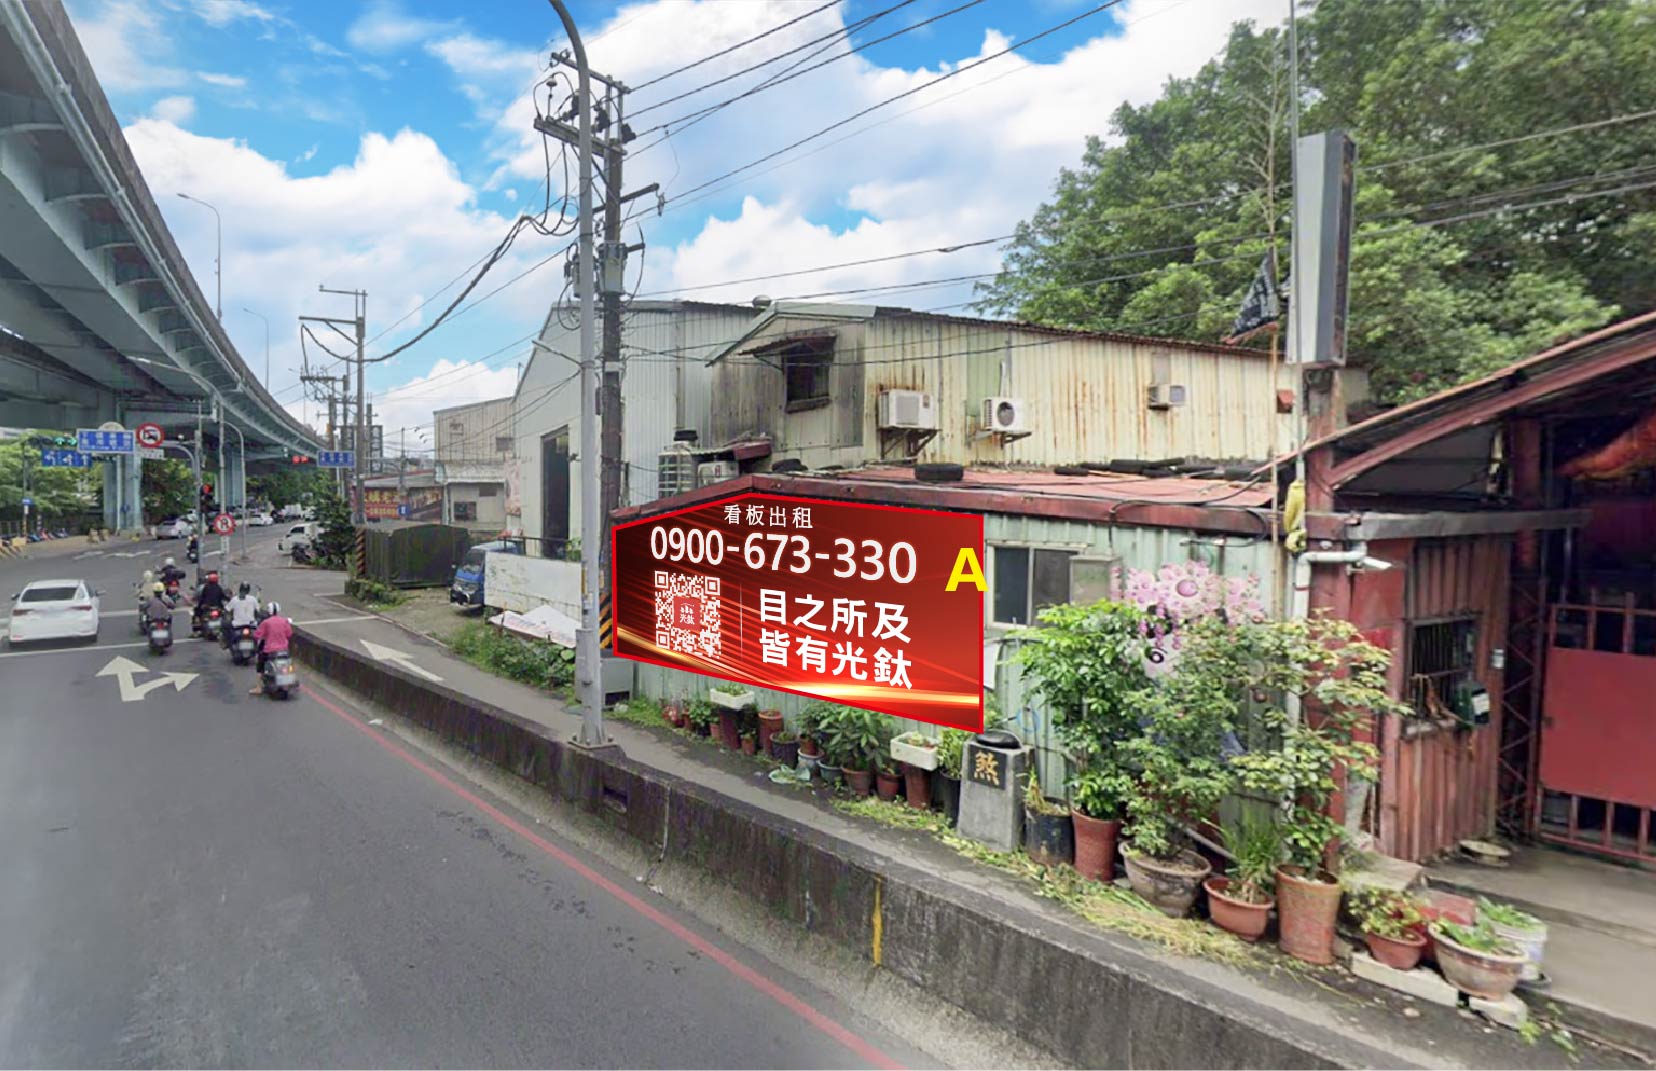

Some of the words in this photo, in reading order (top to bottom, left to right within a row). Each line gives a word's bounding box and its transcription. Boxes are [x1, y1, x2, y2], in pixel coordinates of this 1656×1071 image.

[724, 504, 813, 529] 看板出租
[651, 526, 917, 584] 0900-673-330
[759, 588, 912, 643] 目之所及
[758, 627, 913, 690] 皆有光鈦
